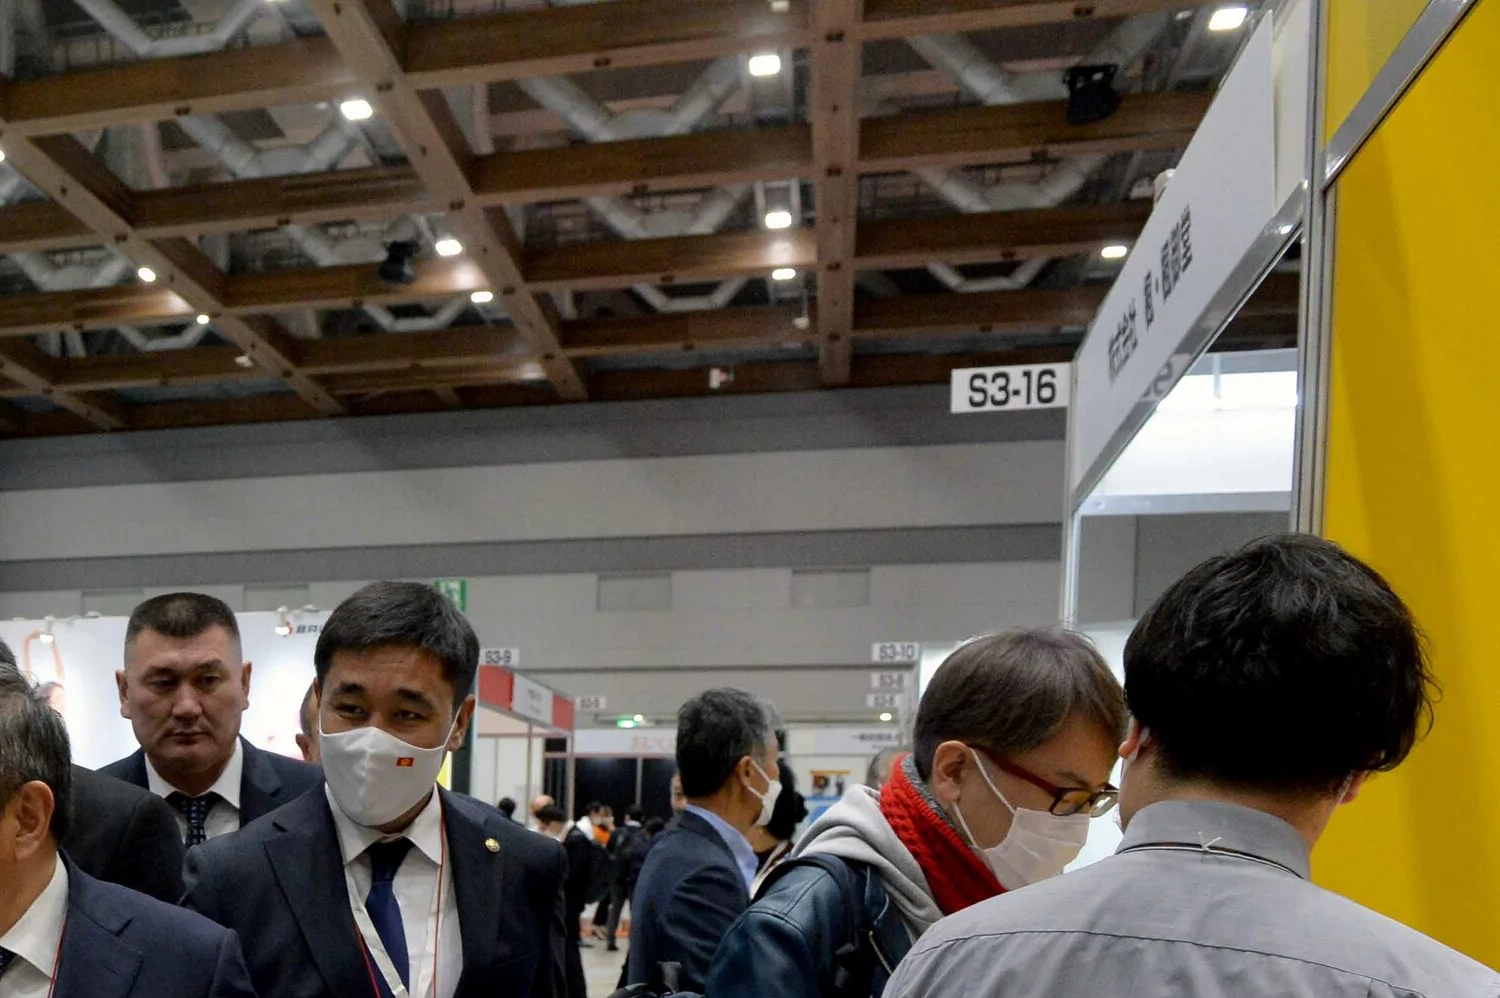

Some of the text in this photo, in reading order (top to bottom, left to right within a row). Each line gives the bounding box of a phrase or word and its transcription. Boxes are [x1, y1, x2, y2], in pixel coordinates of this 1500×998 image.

[968, 369, 1057, 408] S3-16
[485, 650, 512, 664] S3-9
[879, 644, 915, 660] S3-10
